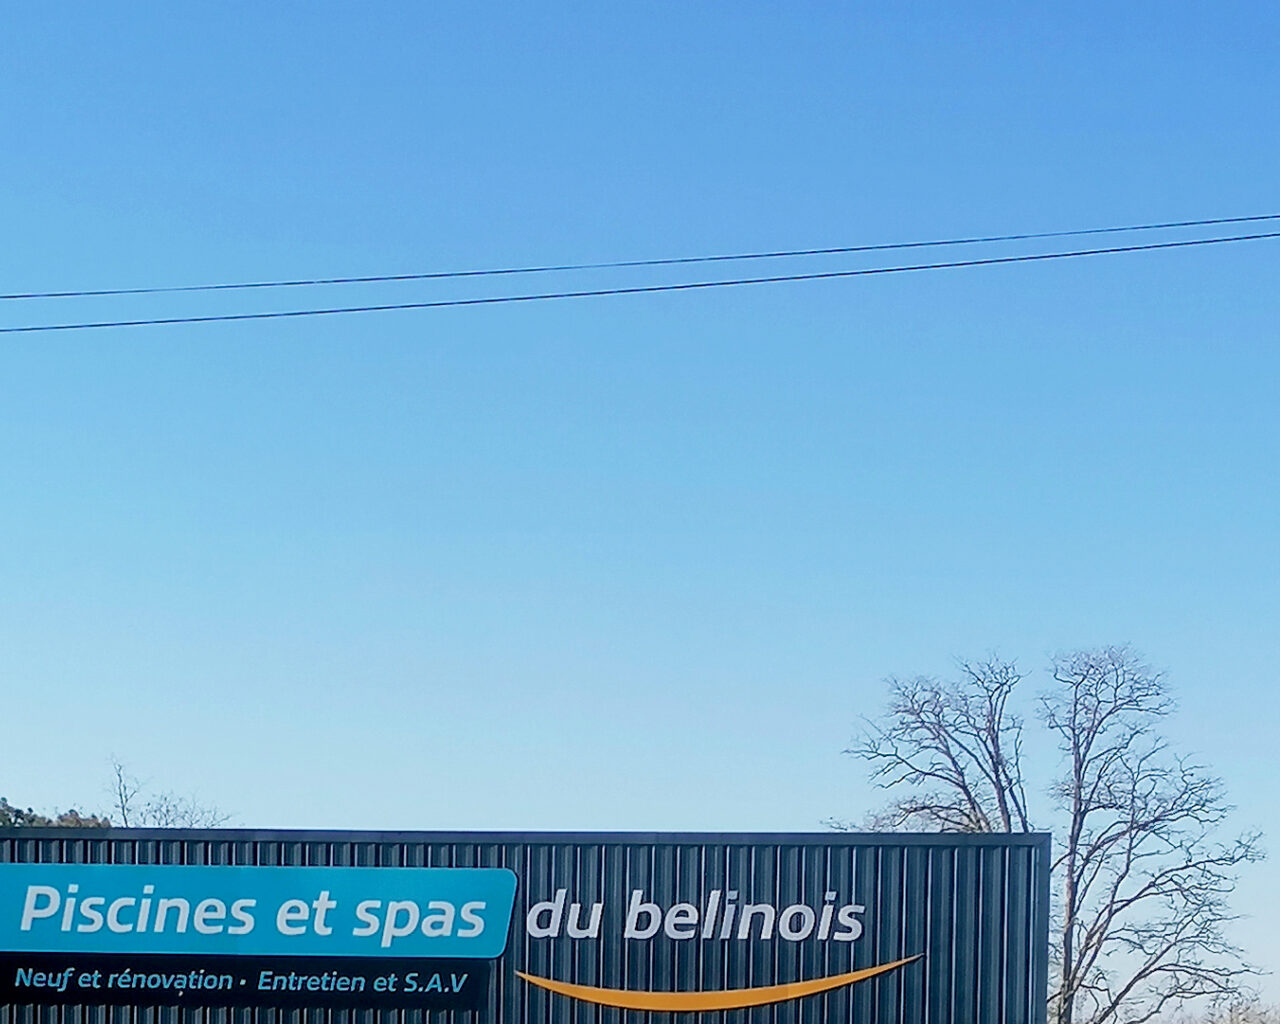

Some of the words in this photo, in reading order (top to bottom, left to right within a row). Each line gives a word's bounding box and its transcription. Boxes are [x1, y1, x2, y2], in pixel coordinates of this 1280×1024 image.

[20, 883, 256, 936] Piscines
[276, 889, 338, 936] et
[352, 899, 487, 948] spas
[526, 888, 603, 939] du
[623, 889, 866, 942] belinois
[14, 967, 74, 992] Neuf
[78, 970, 102, 990] et
[107, 968, 233, 992] rénovation
[258, 970, 366, 992] Entretien
[373, 973, 397, 992] et
[403, 972, 468, 994] S.A.V
